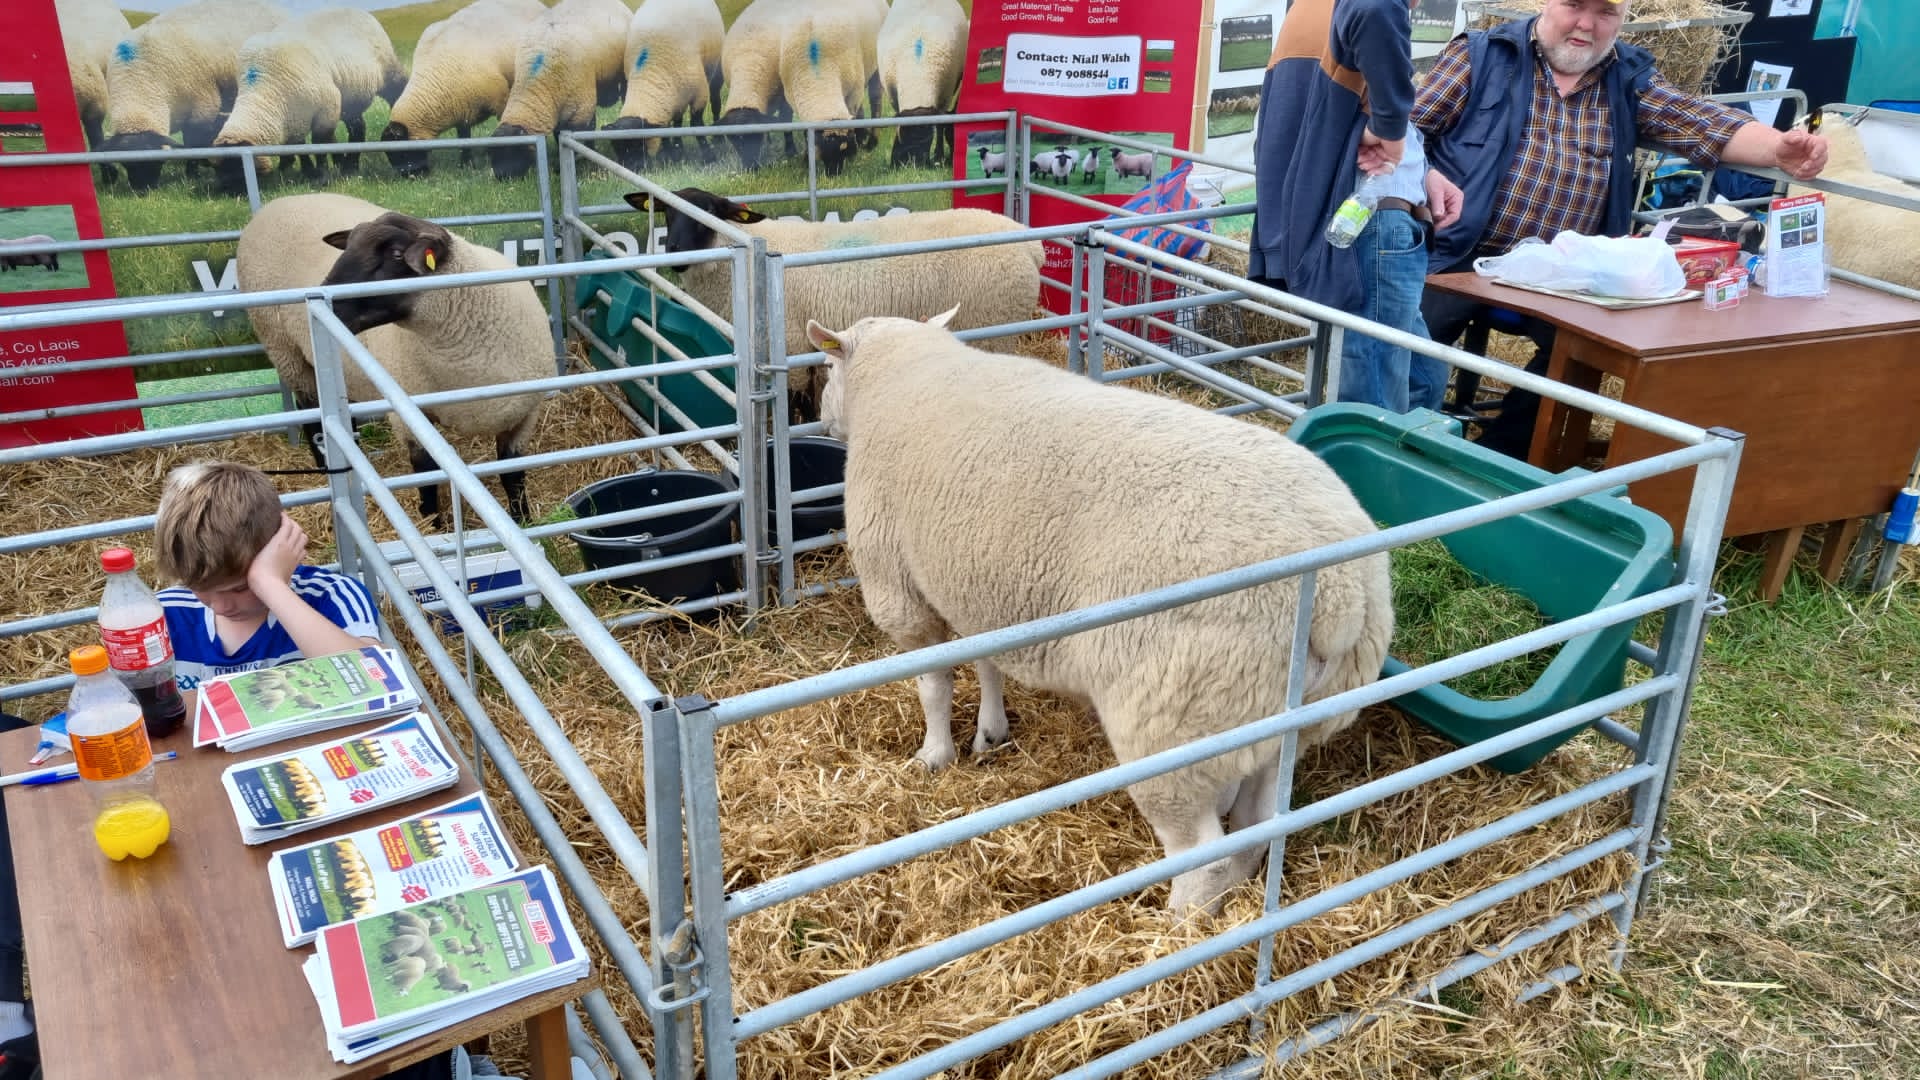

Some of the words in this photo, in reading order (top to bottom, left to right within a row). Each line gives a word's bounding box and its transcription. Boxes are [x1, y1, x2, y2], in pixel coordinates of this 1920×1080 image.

[1016, 50, 1068, 64] Contact:
[1071, 53, 1099, 64] Niall
[1101, 52, 1131, 63] Walsh
[1040, 67, 1062, 79] 087
[1065, 69, 1109, 80] 9088544
[13, 342, 35, 354] Co
[39, 338, 80, 352] Laois
